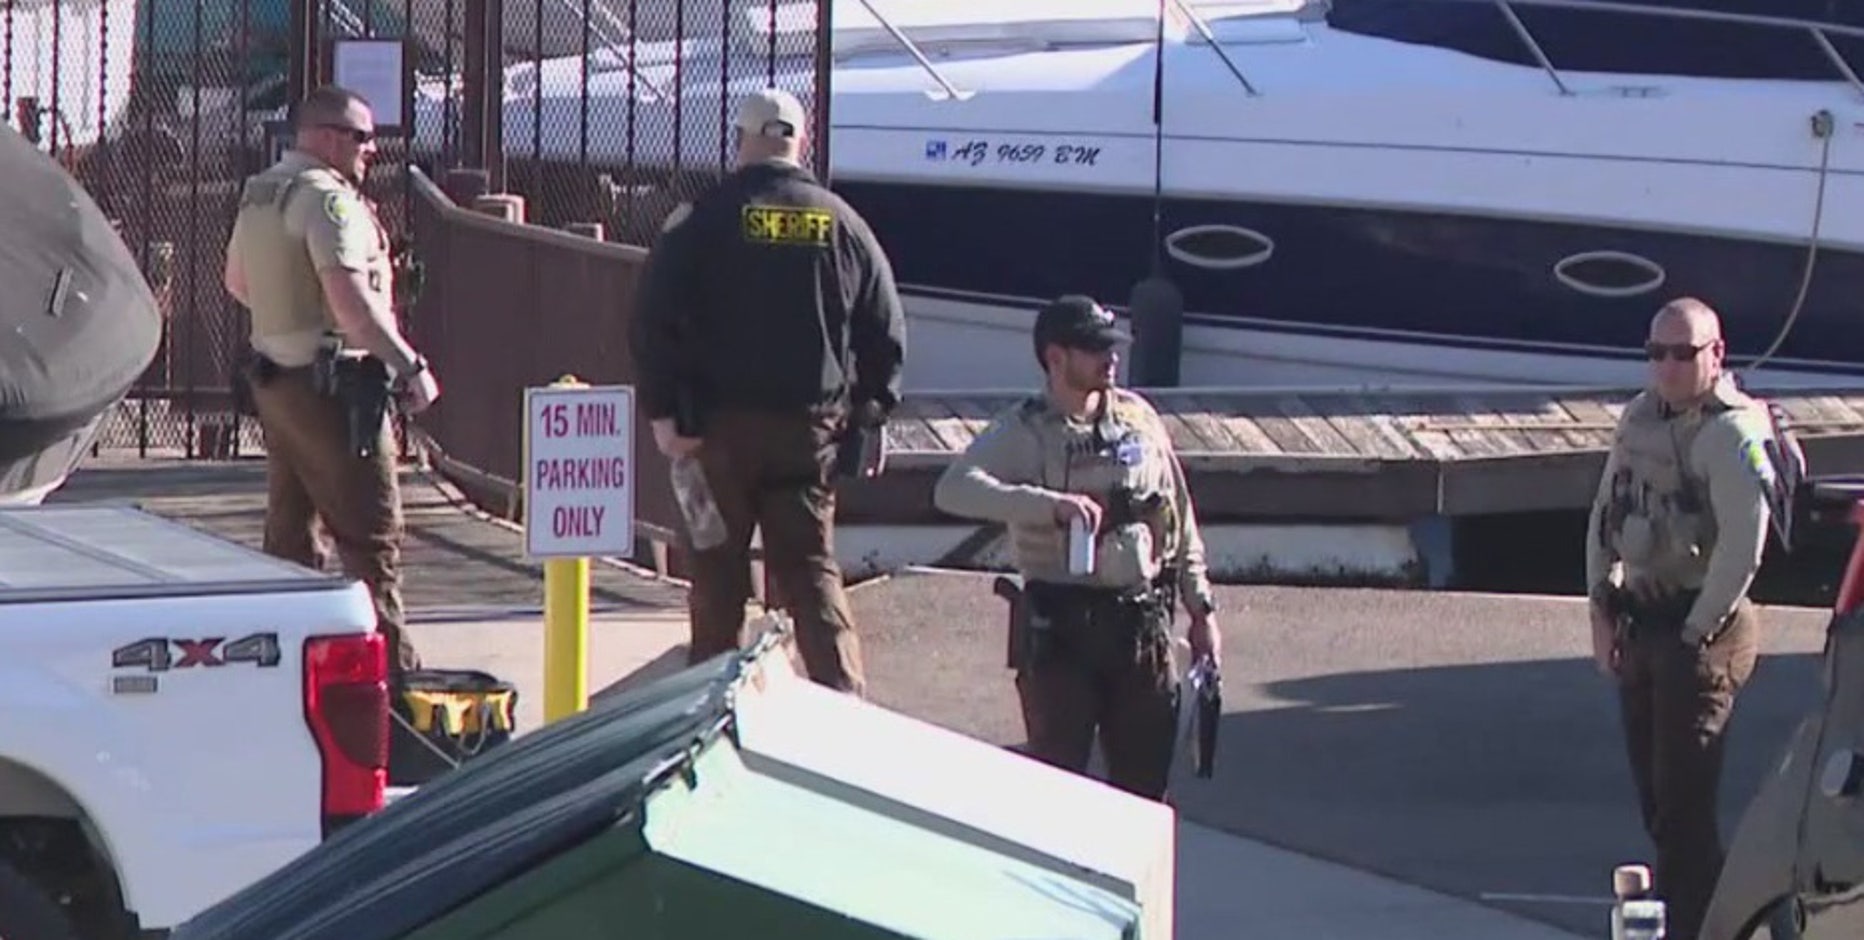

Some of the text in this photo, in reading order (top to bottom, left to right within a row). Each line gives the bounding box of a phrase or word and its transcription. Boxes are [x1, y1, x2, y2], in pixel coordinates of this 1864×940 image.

[951, 140, 989, 166] AZ
[1055, 144, 1101, 166] BM
[746, 209, 832, 239] SHERIFF
[541, 402, 621, 438] 15 MIN.
[536, 457, 624, 490] PARKING
[553, 505, 605, 538] ONLY
